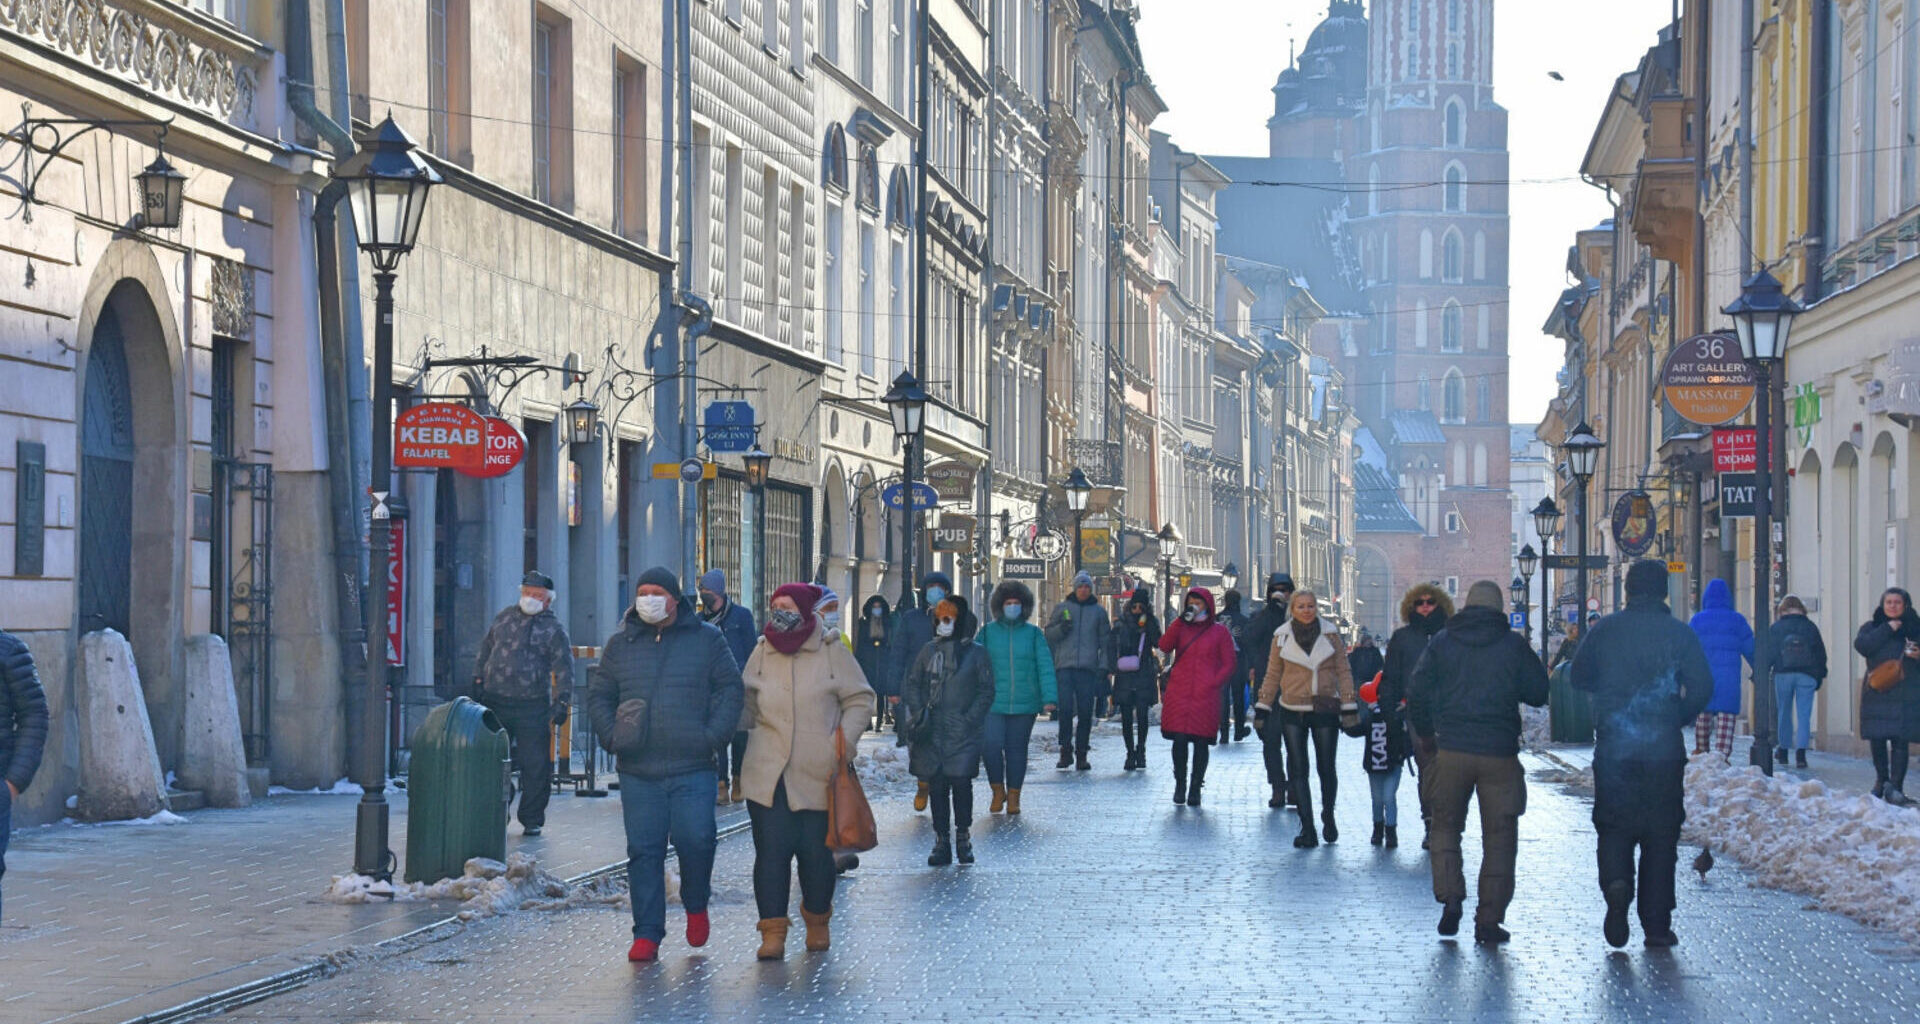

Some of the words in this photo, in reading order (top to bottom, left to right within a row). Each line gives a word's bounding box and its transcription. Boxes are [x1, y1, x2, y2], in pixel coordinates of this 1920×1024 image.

[146, 192, 164, 208] 53
[1695, 339, 1724, 359] 36
[1672, 363, 1694, 372] ART
[1697, 363, 1747, 372] GALLERY
[1668, 376, 1705, 384] OPRAWA
[1678, 390, 1741, 400] MASSAGE
[406, 407, 479, 425] BEIRUT
[400, 427, 480, 445] KEBAB
[1717, 433, 1757, 444] KANT
[487, 436, 518, 449] TOR
[402, 448, 451, 459] FALAFEL
[935, 529, 967, 542] PUB
[1005, 564, 1043, 574] HOSTEL
[1513, 614, 1523, 626] P
[1371, 722, 1388, 770] KARL
